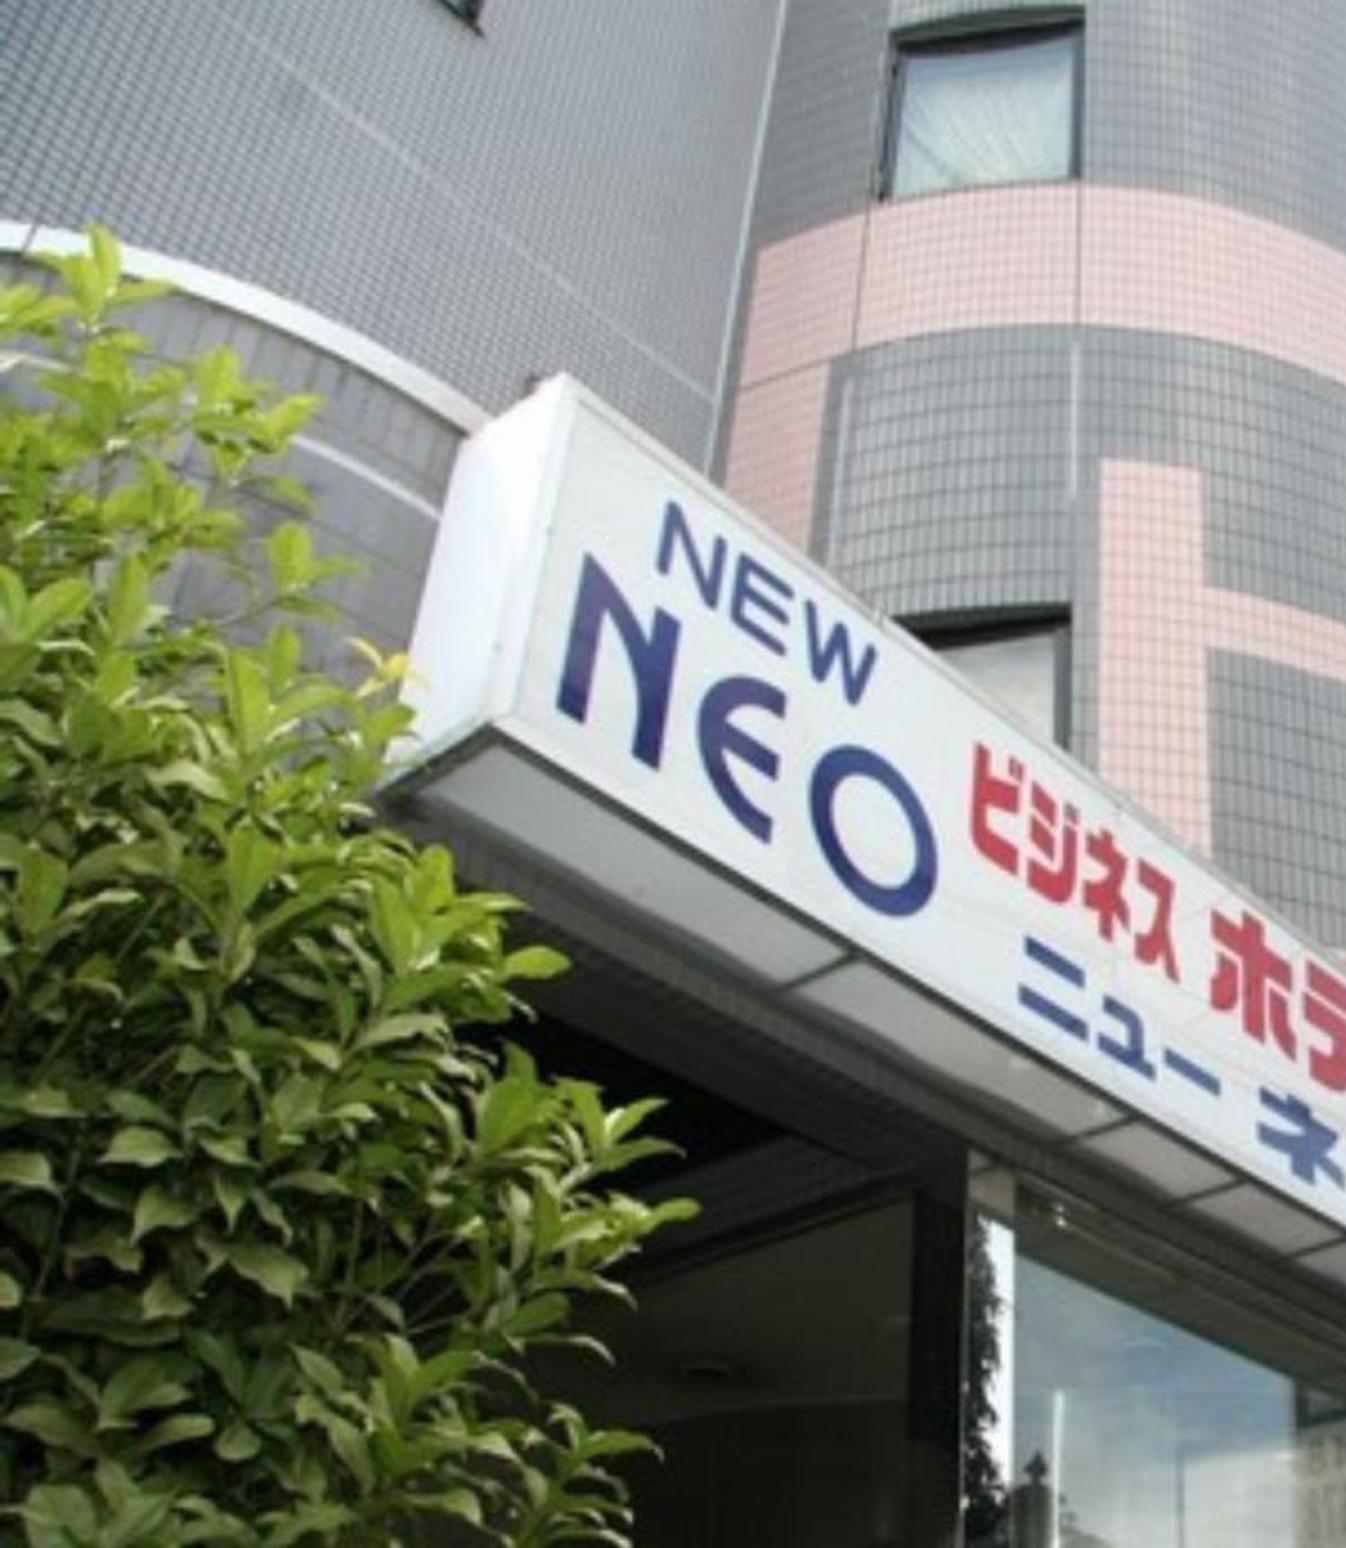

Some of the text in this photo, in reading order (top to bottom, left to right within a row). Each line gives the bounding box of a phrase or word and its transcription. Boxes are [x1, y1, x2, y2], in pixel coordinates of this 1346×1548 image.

[656, 500, 877, 706] NEW
[555, 552, 938, 918] NEO
[970, 741, 1181, 984] ビジネス
